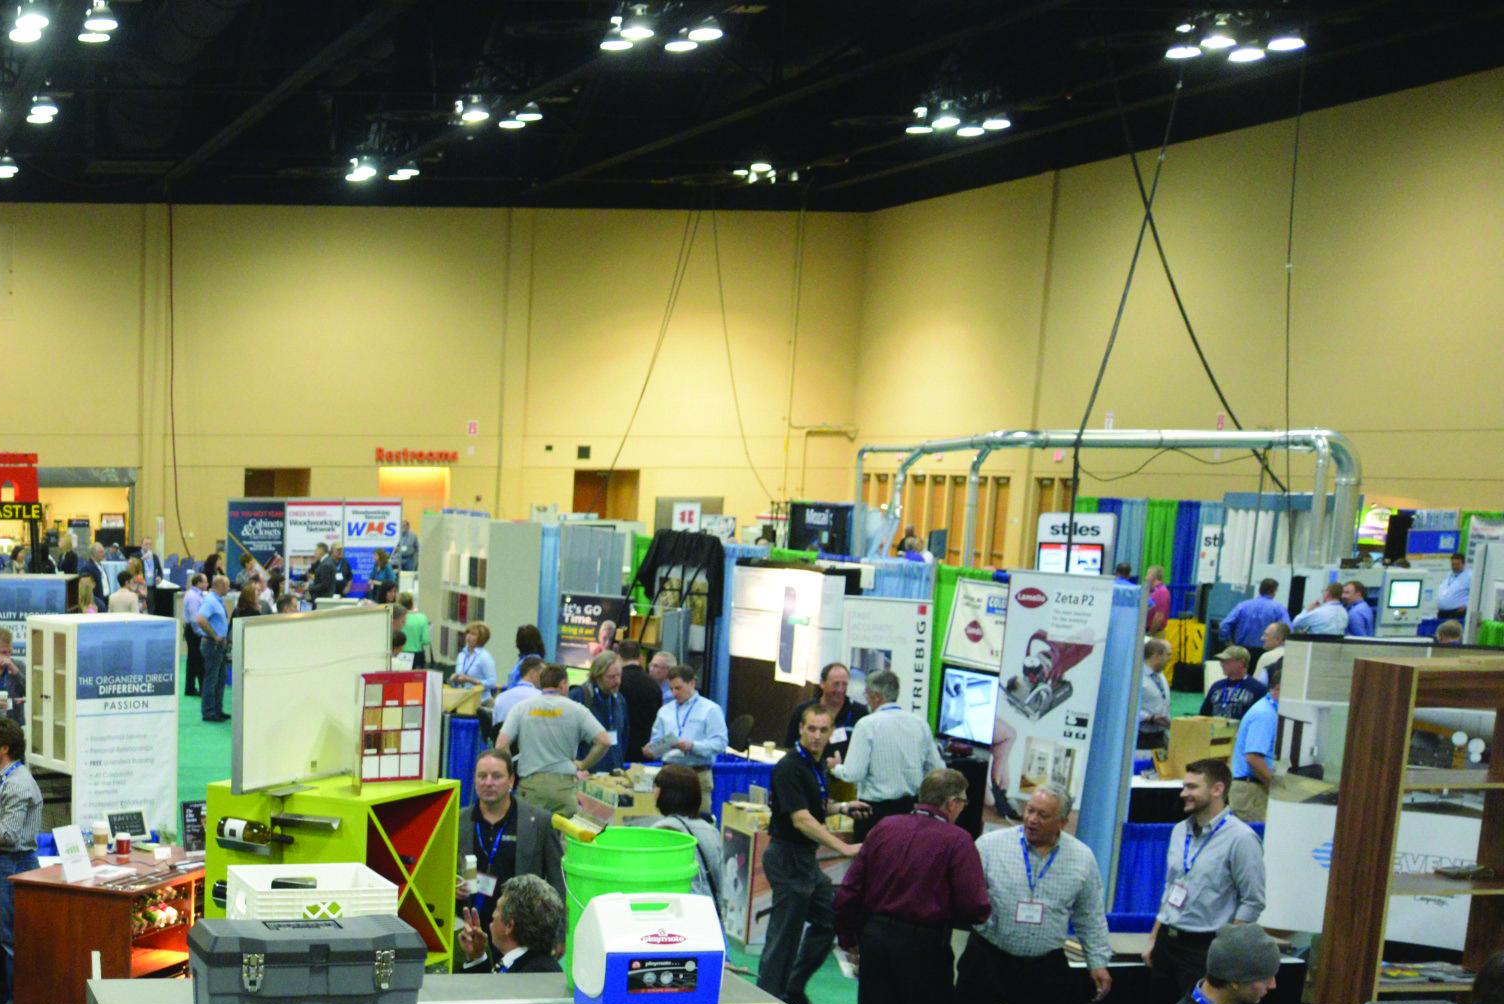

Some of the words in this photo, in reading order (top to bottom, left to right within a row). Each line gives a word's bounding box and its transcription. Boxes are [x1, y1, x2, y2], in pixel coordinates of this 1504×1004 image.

[376, 448, 459, 464] Restrooms
[248, 518, 283, 528] Cabinets
[289, 519, 340, 527] Woodworking
[1050, 522, 1100, 537] stles
[1055, 592, 1079, 605] Zeta
[1081, 595, 1095, 606] P2
[564, 603, 581, 614] It's
[584, 604, 602, 616] GO
[79, 677, 93, 686] THE
[96, 674, 143, 685] ORGANIZER
[146, 673, 173, 682] DIRECT
[99, 683, 155, 695] DIFFERENCE:
[104, 700, 149, 710] PASSION
